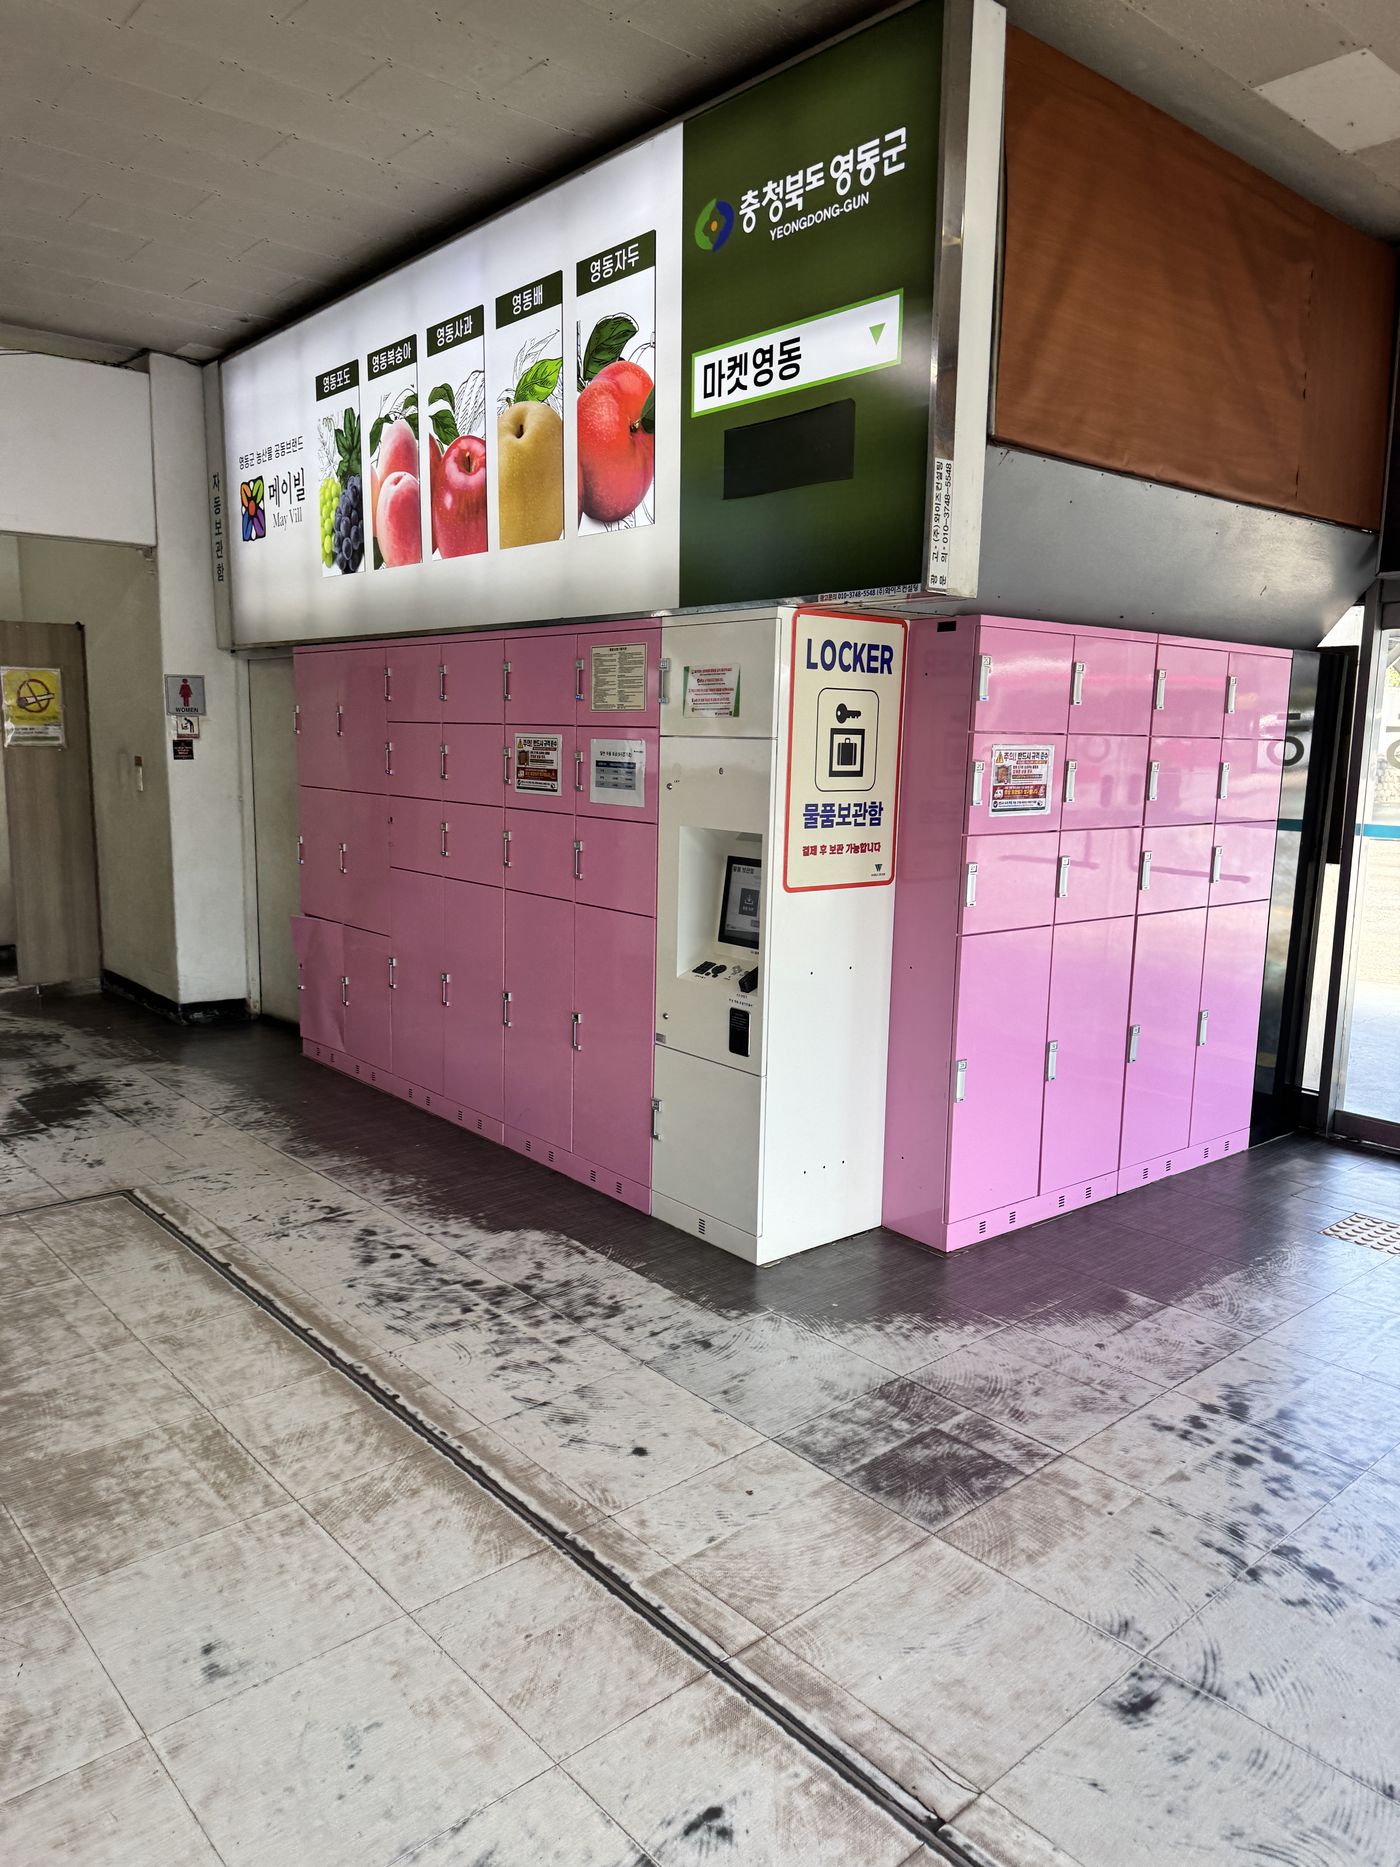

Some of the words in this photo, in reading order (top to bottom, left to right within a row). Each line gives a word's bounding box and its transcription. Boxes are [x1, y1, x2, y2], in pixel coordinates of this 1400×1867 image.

[739, 162, 825, 233] 충청북도
[830, 127, 907, 196] 영동군
[769, 192, 869, 241] YEONGDONG-GUN
[590, 243, 639, 283] 영동자두
[512, 284, 543, 315] 영동배
[436, 315, 473, 347] 영동사과
[372, 342, 412, 373] 영동복숭아
[703, 337, 802, 399] 마켓영동
[322, 368, 351, 393] 영동포도
[239, 453, 254, 470] 영동군
[256, 446, 272, 464] 농산물
[274, 435, 303, 458] 공동브랜드
[268, 467, 306, 508] 메이빌
[273, 512, 287, 531] May
[288, 507, 303, 526] Vill
[806, 638, 894, 675] LOCKER
[803, 801, 884, 829] 물품보관함
[802, 845, 817, 857] 결제
[819, 844, 827, 856] 후
[829, 843, 844, 855] 보관
[845, 841, 882, 854] 가능합니다
